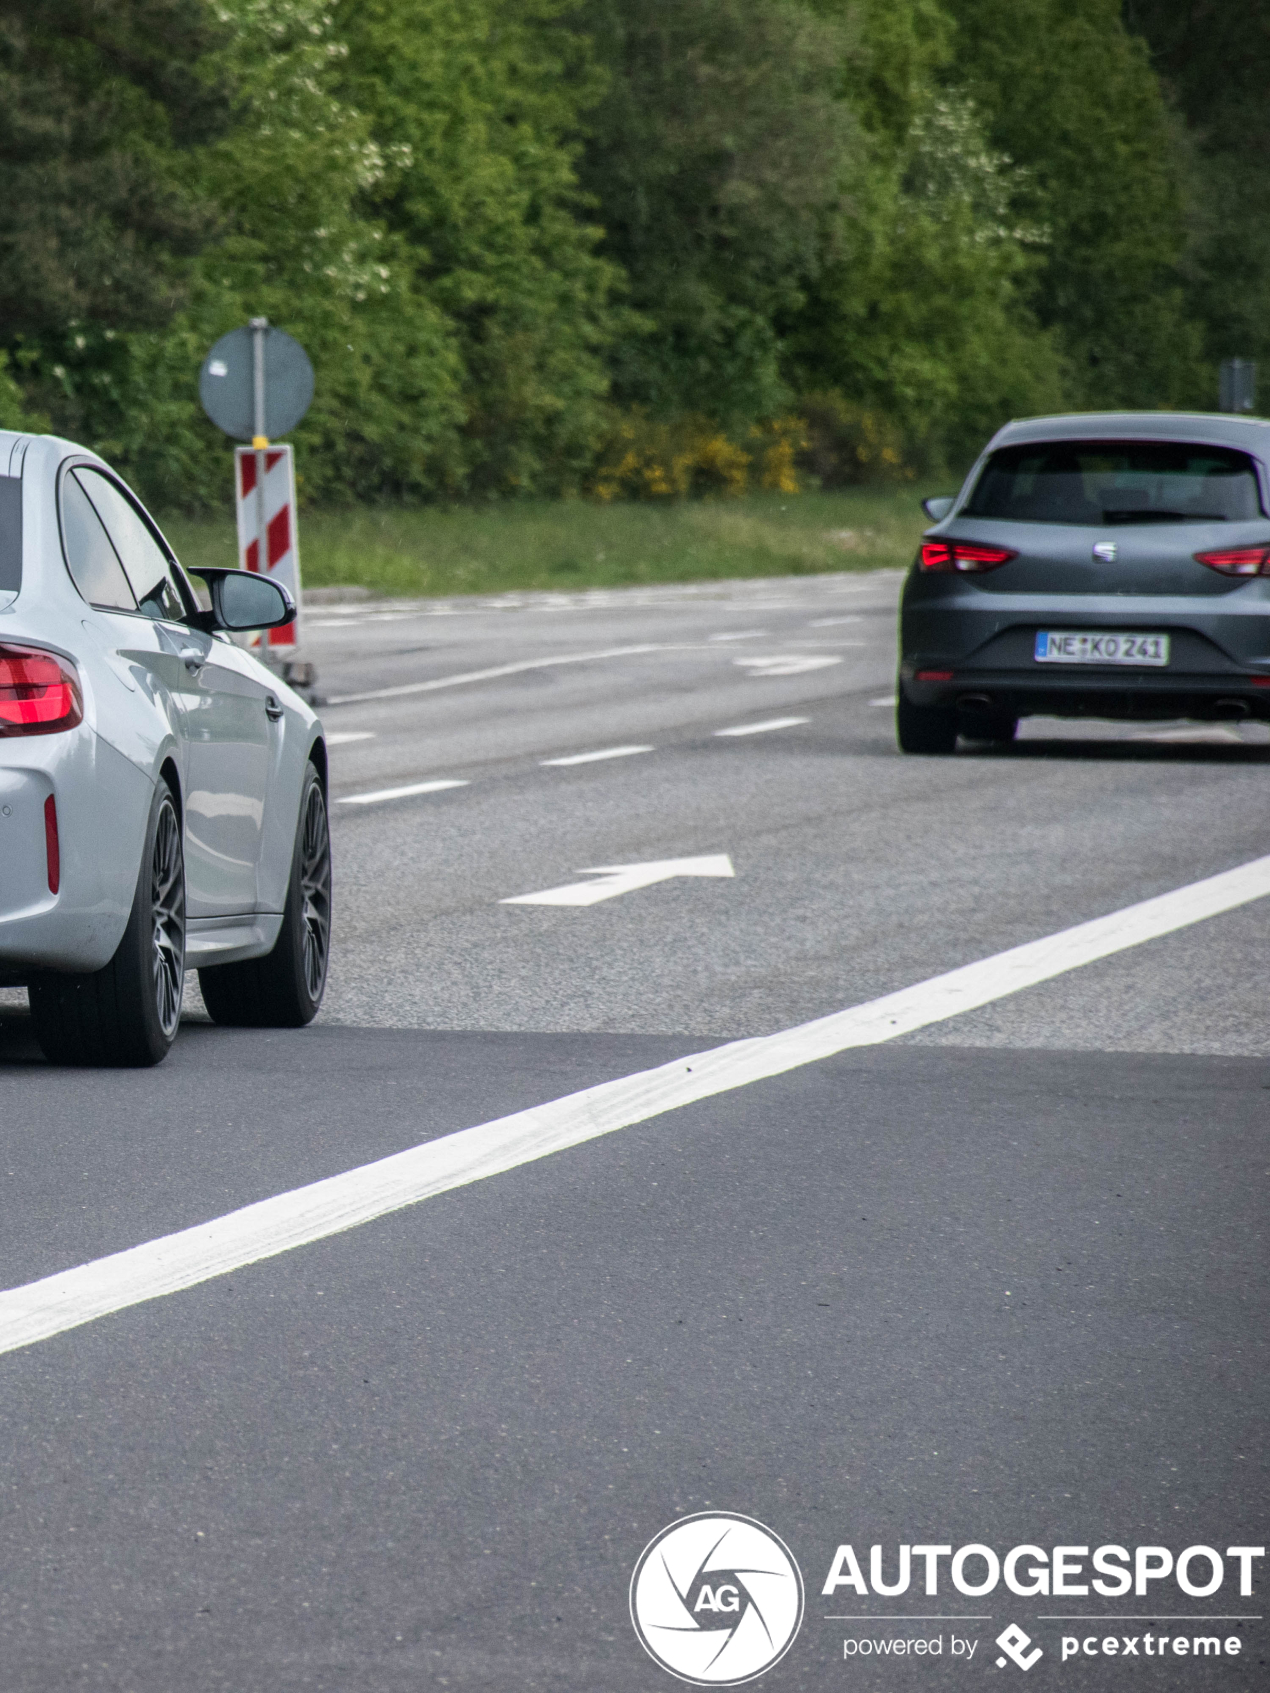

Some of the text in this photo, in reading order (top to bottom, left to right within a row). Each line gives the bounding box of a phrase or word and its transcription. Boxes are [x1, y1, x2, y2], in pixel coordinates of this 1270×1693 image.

[1049, 636, 1162, 659] NE KO 241
